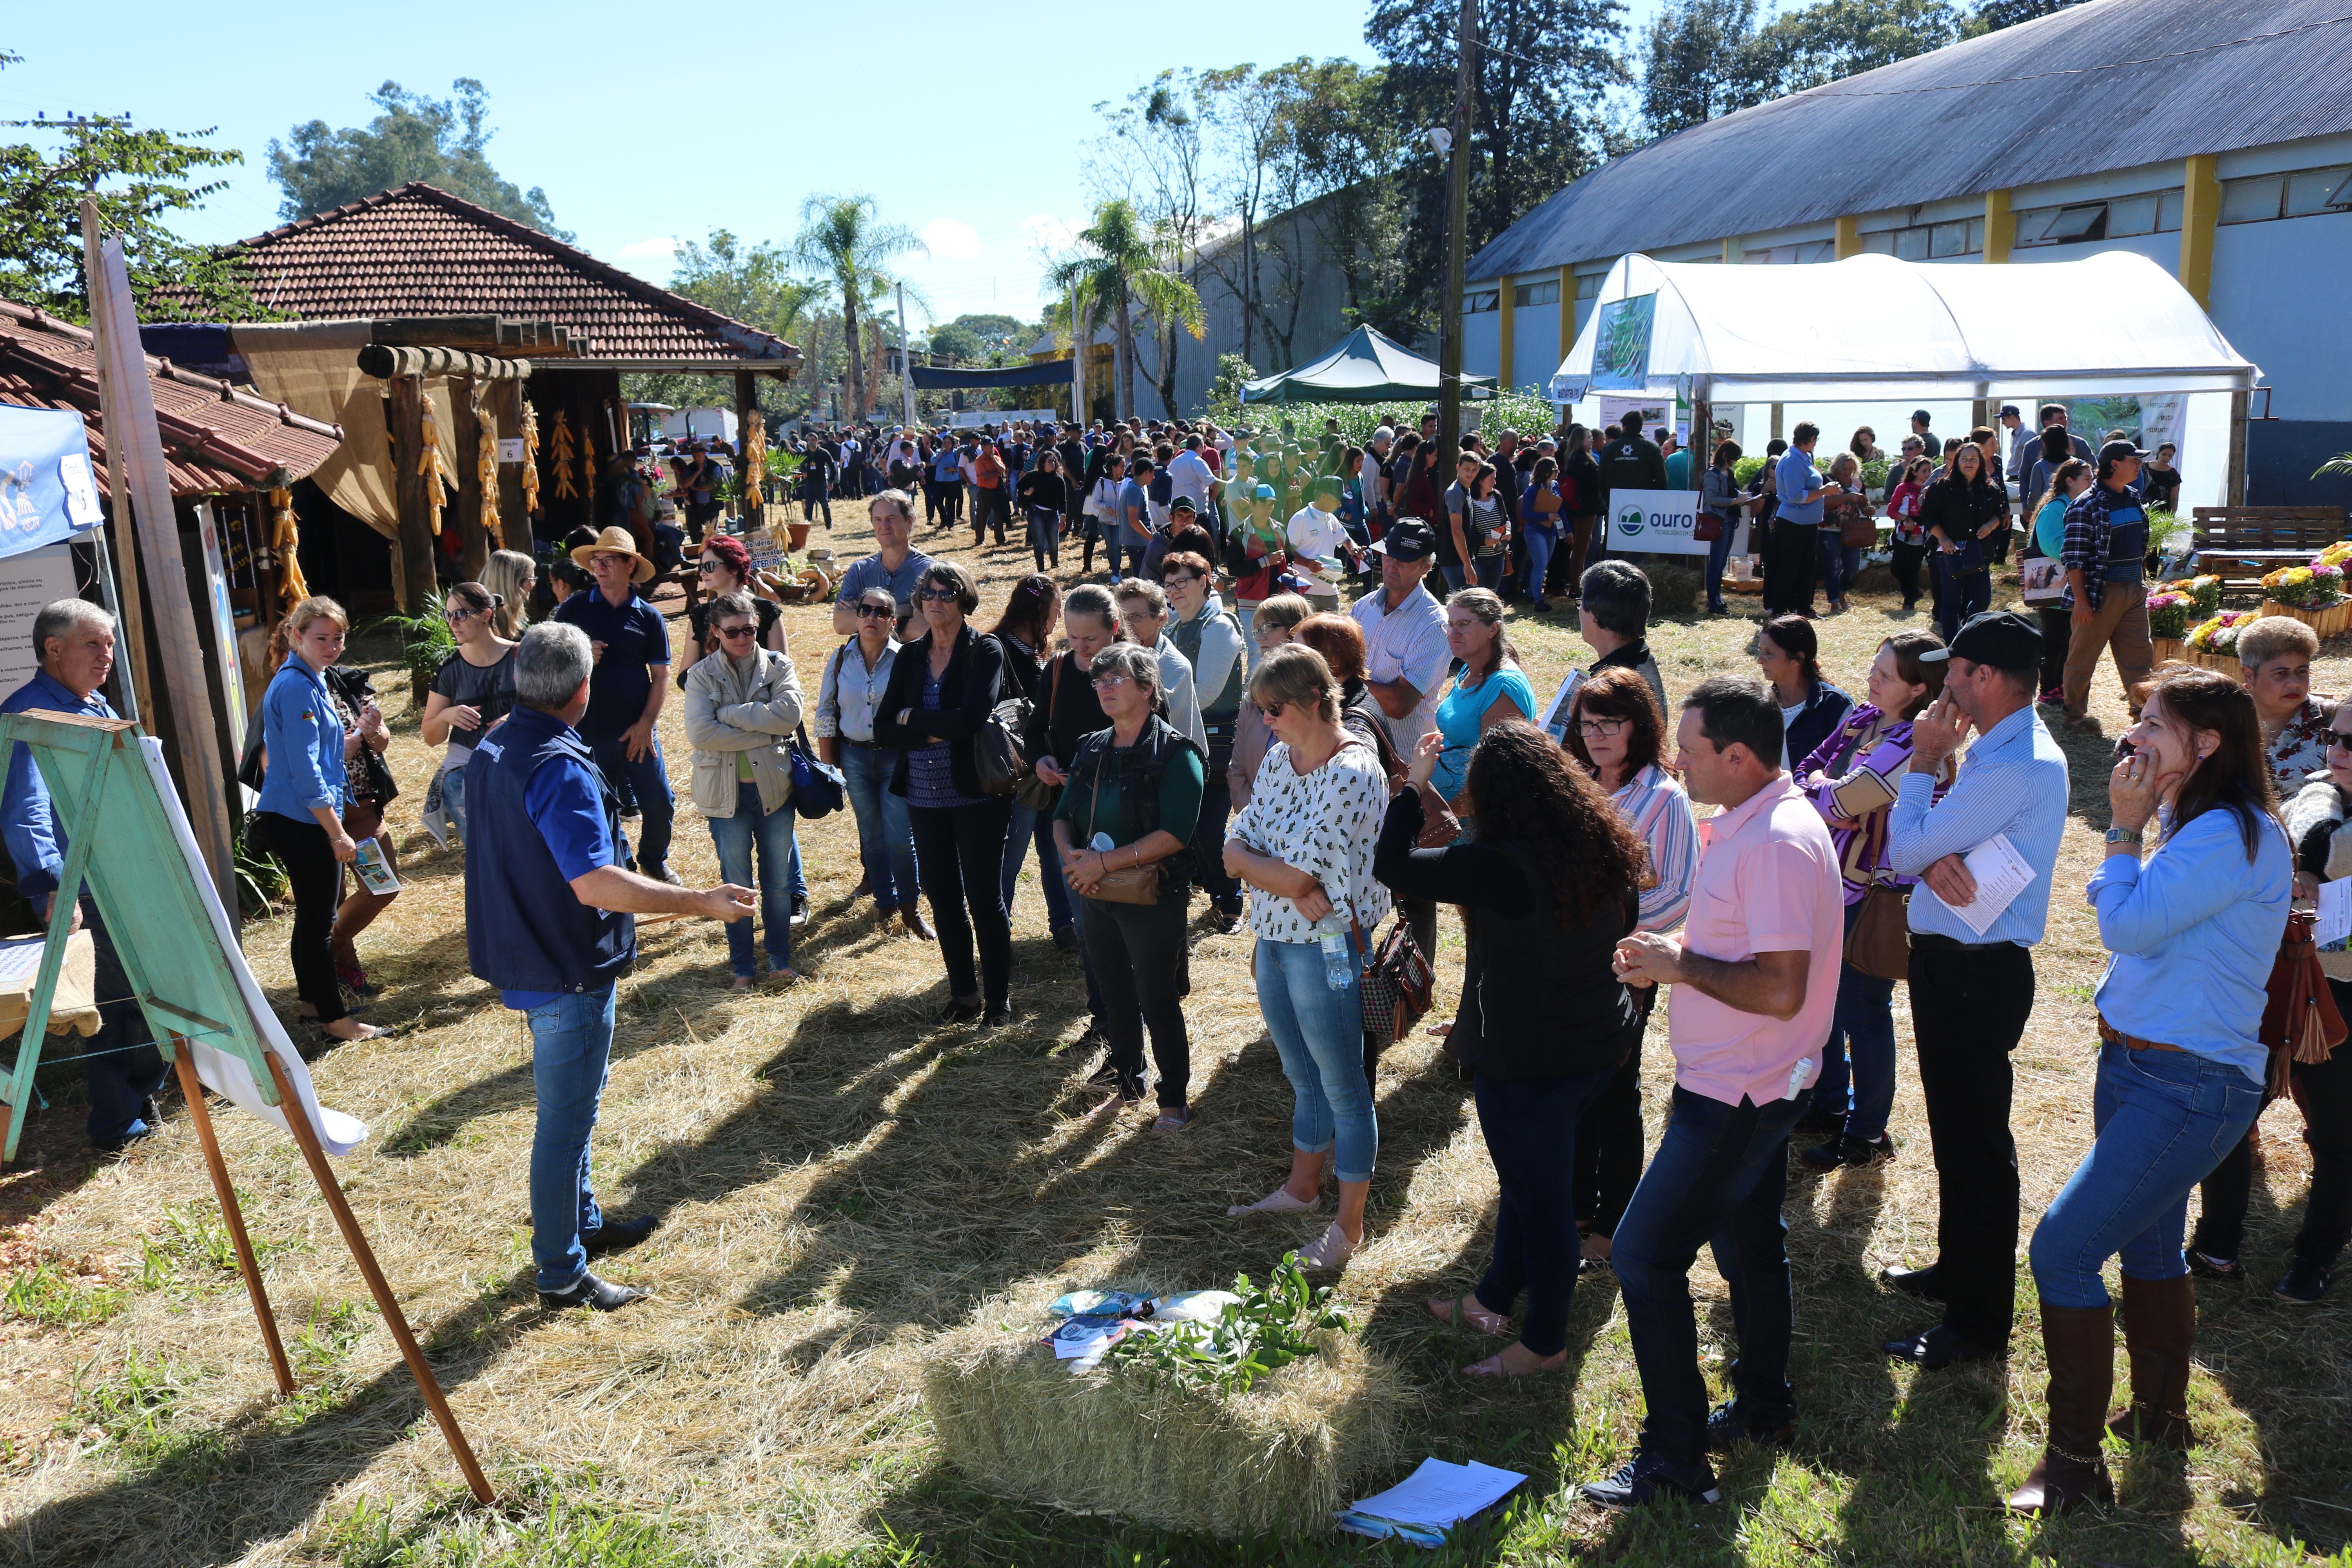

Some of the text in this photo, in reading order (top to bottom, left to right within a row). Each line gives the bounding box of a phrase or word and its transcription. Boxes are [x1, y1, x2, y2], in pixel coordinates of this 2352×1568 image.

[1650, 513, 1692, 528] ouro
[755, 539, 773, 547] ideias
[753, 548, 783, 558] alimentos
